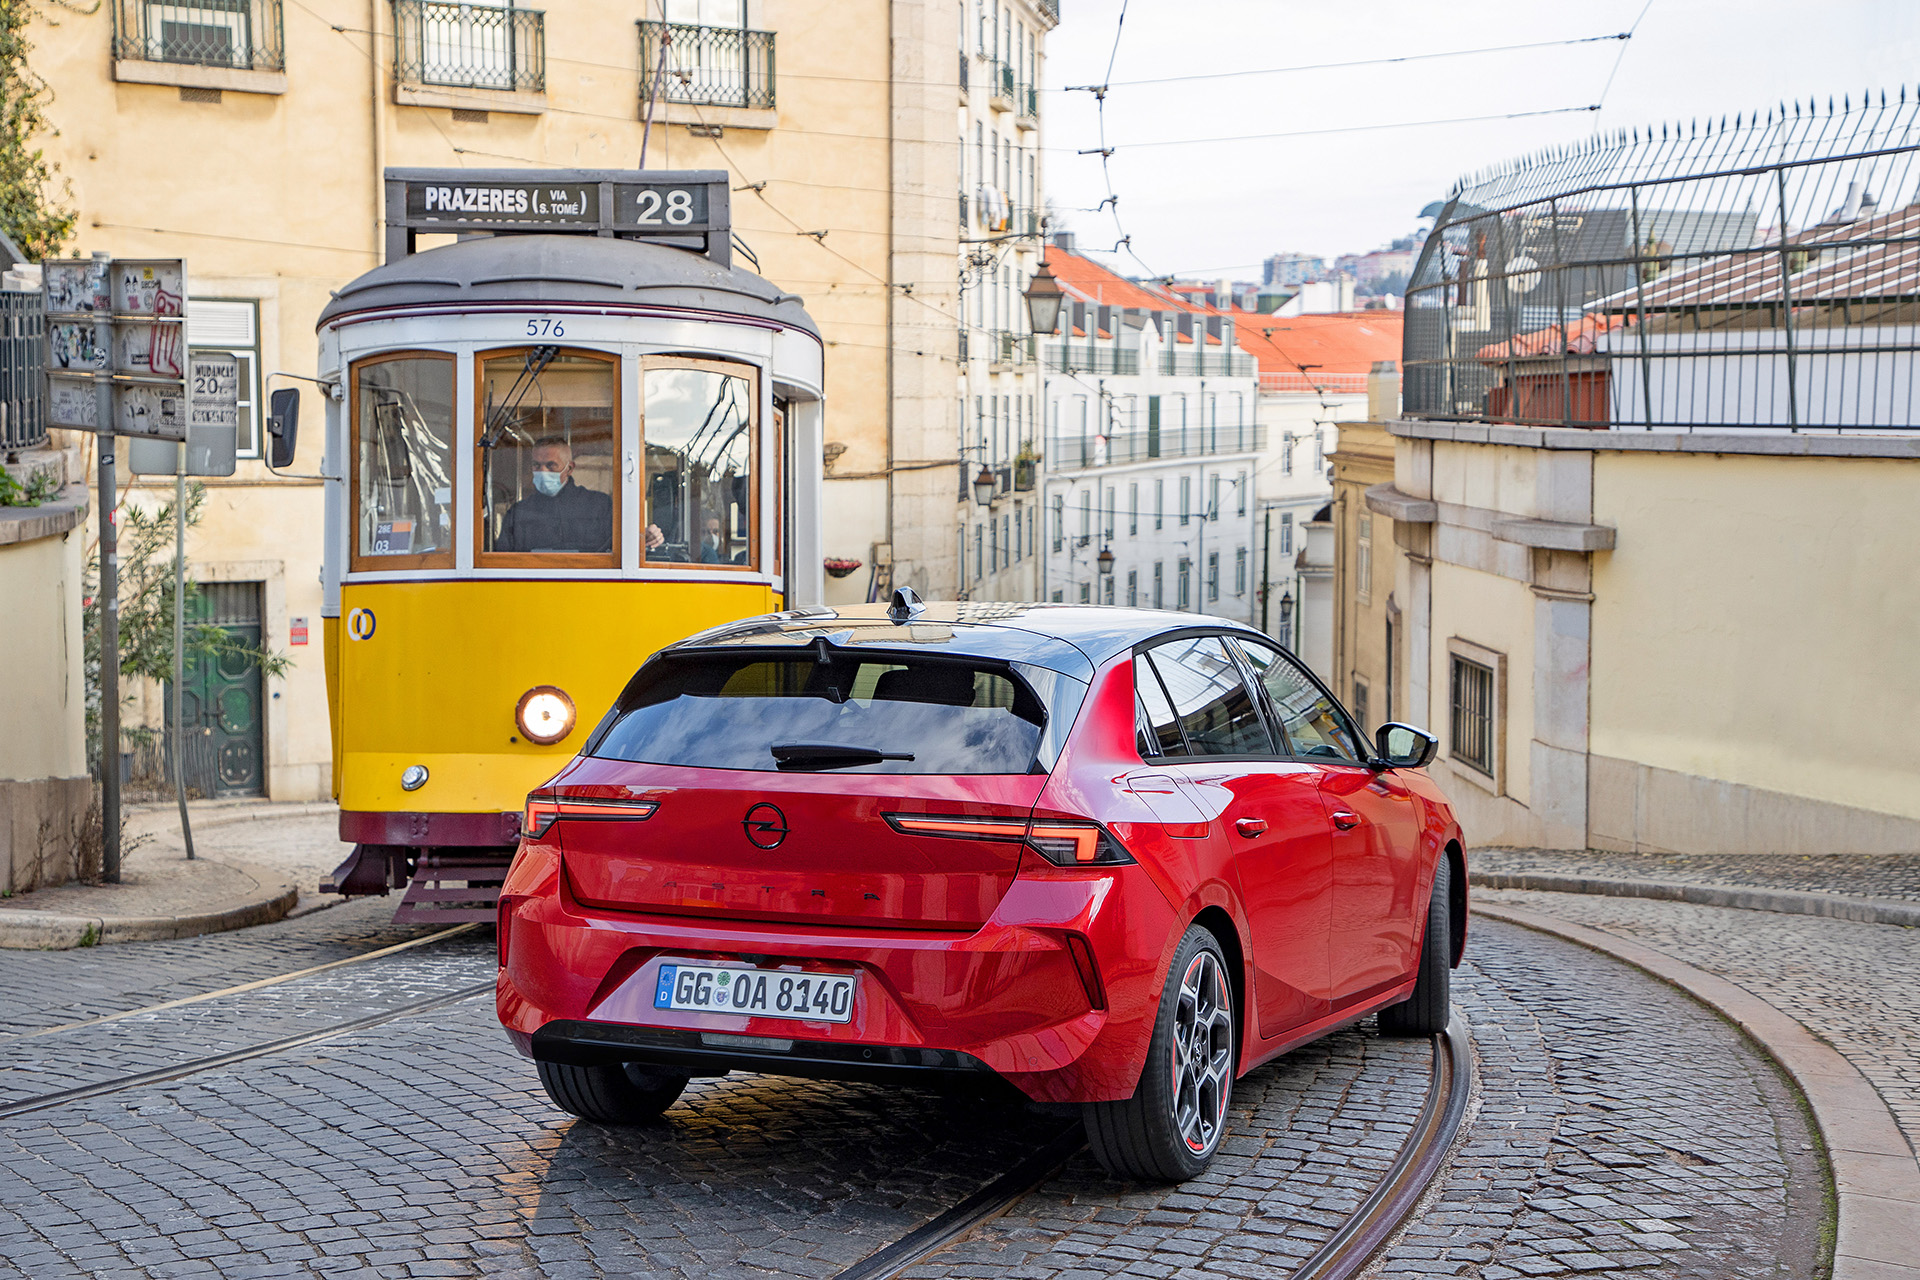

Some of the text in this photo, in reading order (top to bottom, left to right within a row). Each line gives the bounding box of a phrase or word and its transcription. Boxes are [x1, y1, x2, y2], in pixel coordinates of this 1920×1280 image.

[425, 186, 528, 214] PRAZERES
[550, 190, 567, 201] VIA
[551, 201, 579, 215] TOMÉ
[636, 189, 694, 225] 28
[527, 319, 564, 337] 576
[378, 524, 391, 534] 28E
[375, 540, 389, 552] 03
[663, 881, 880, 901] ASTRA
[675, 971, 850, 1016] GG OA 8140
